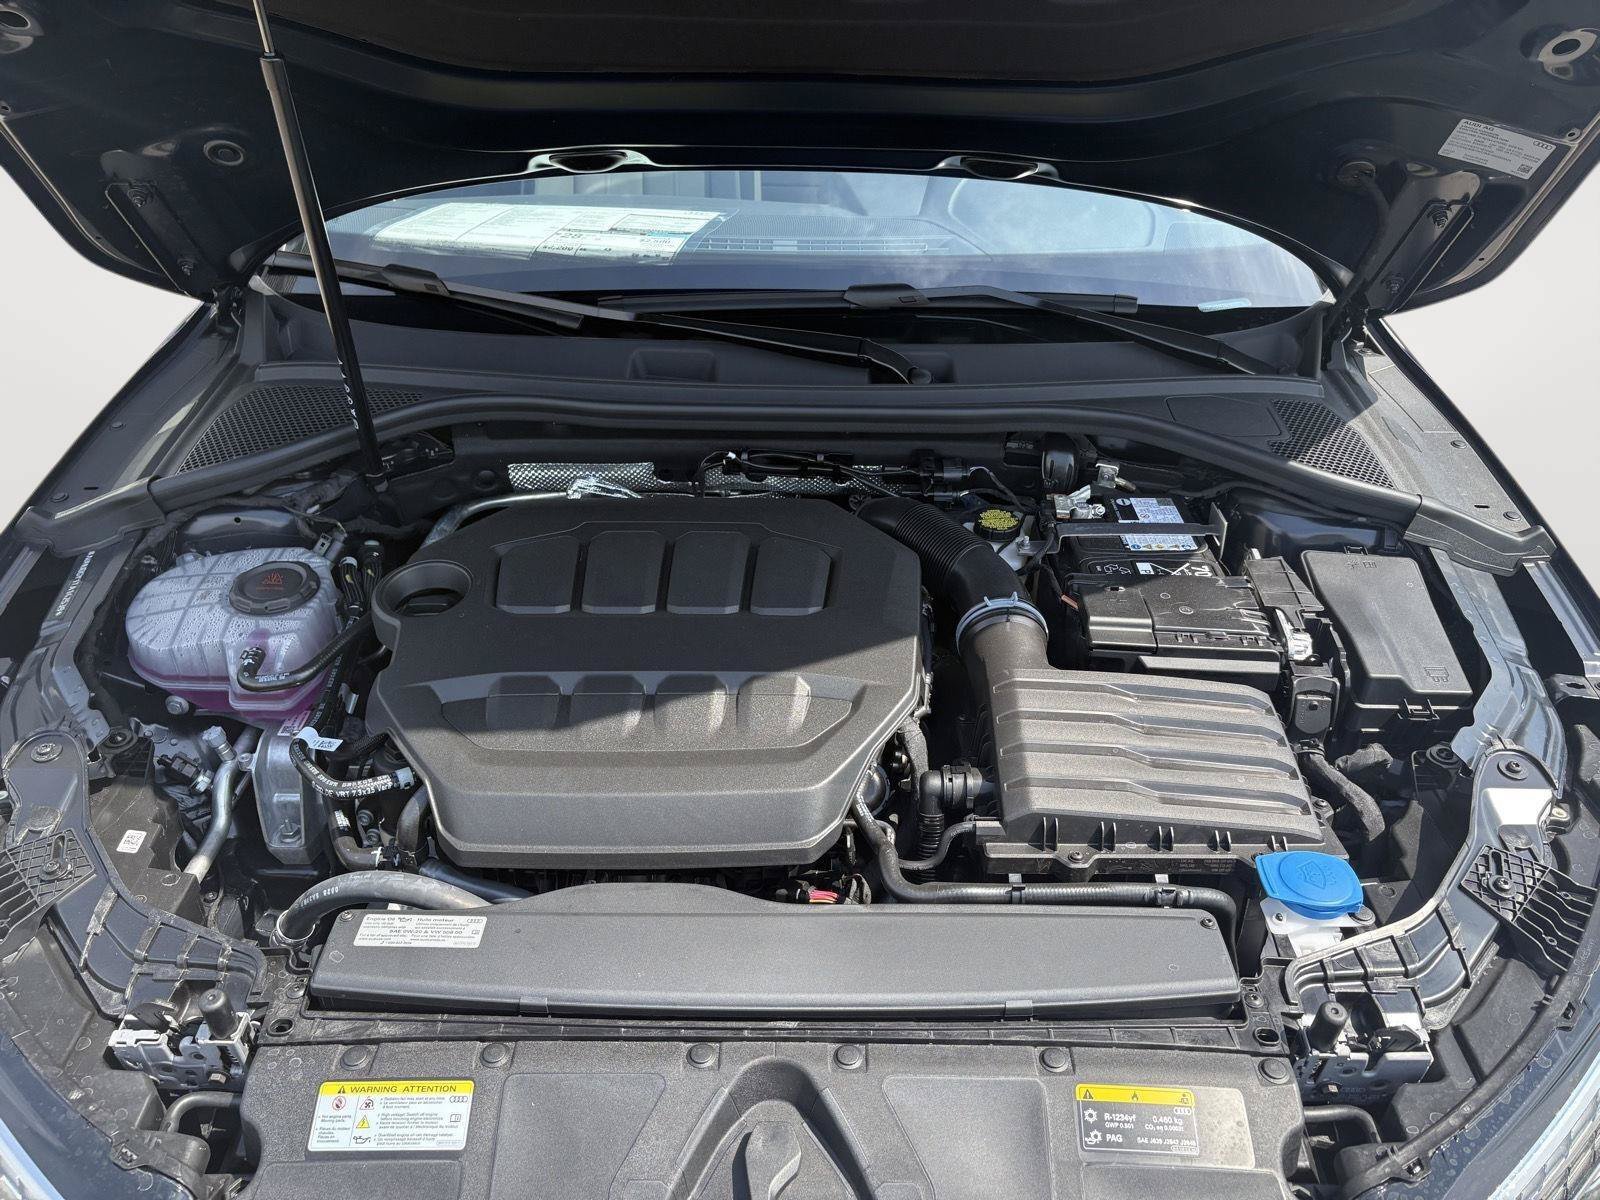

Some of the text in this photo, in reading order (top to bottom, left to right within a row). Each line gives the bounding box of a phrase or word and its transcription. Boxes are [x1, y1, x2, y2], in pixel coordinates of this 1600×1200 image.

[1104, 1112, 1137, 1122] R-1234yf
[1173, 1117, 1183, 1125] kg
[1106, 1134, 1123, 1142] PAG
